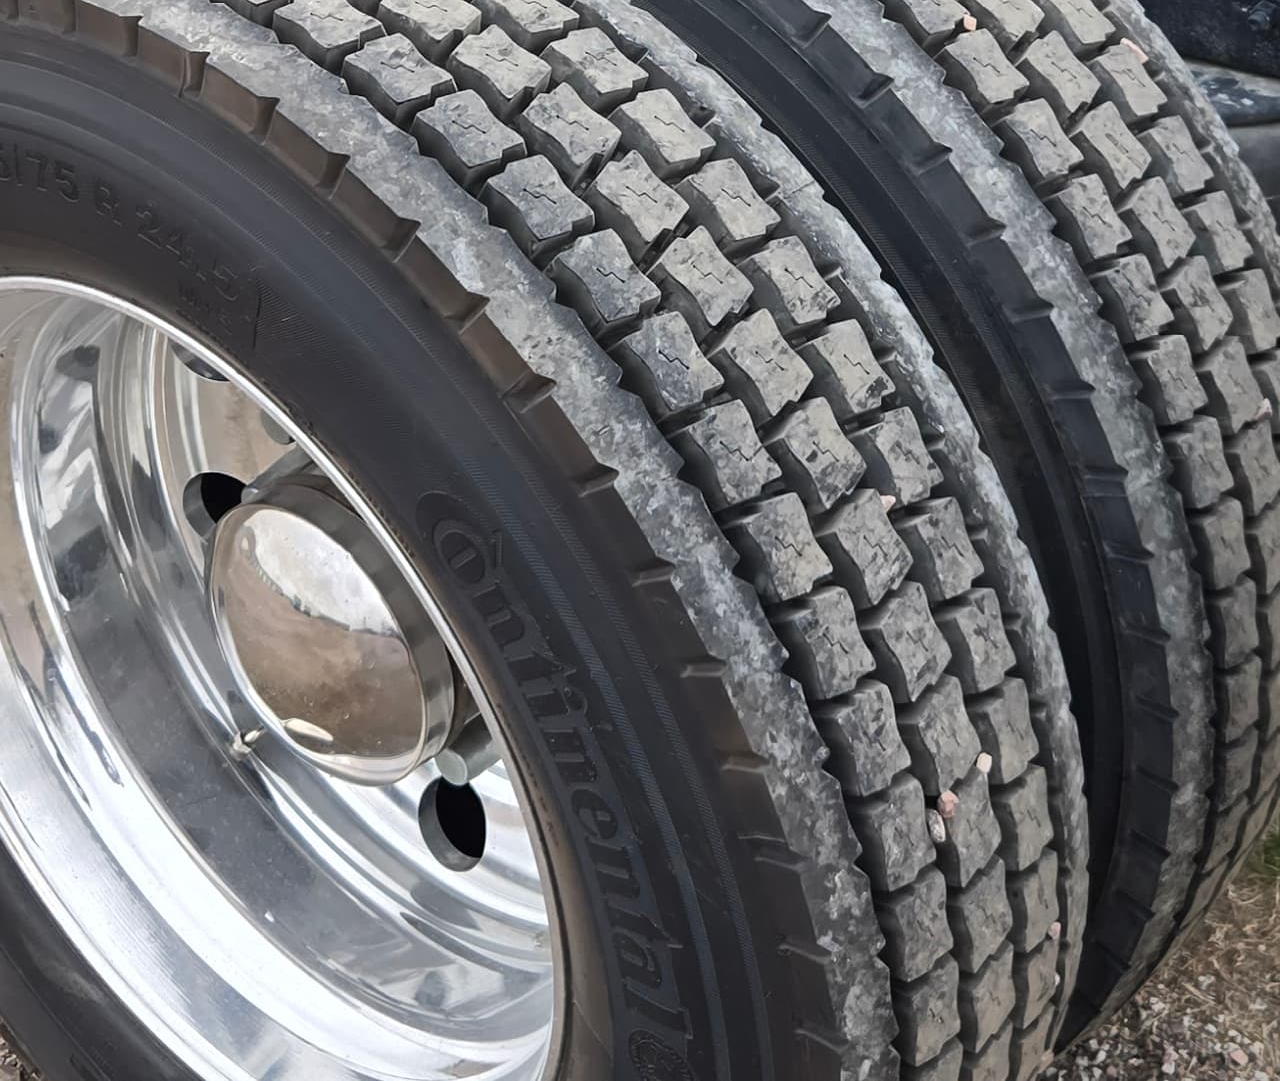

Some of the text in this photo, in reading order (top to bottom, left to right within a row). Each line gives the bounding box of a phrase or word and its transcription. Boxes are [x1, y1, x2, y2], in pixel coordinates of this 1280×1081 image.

[93, 183, 124, 227] R
[135, 202, 240, 303] 24.5
[417, 490, 694, 1040] Continental
